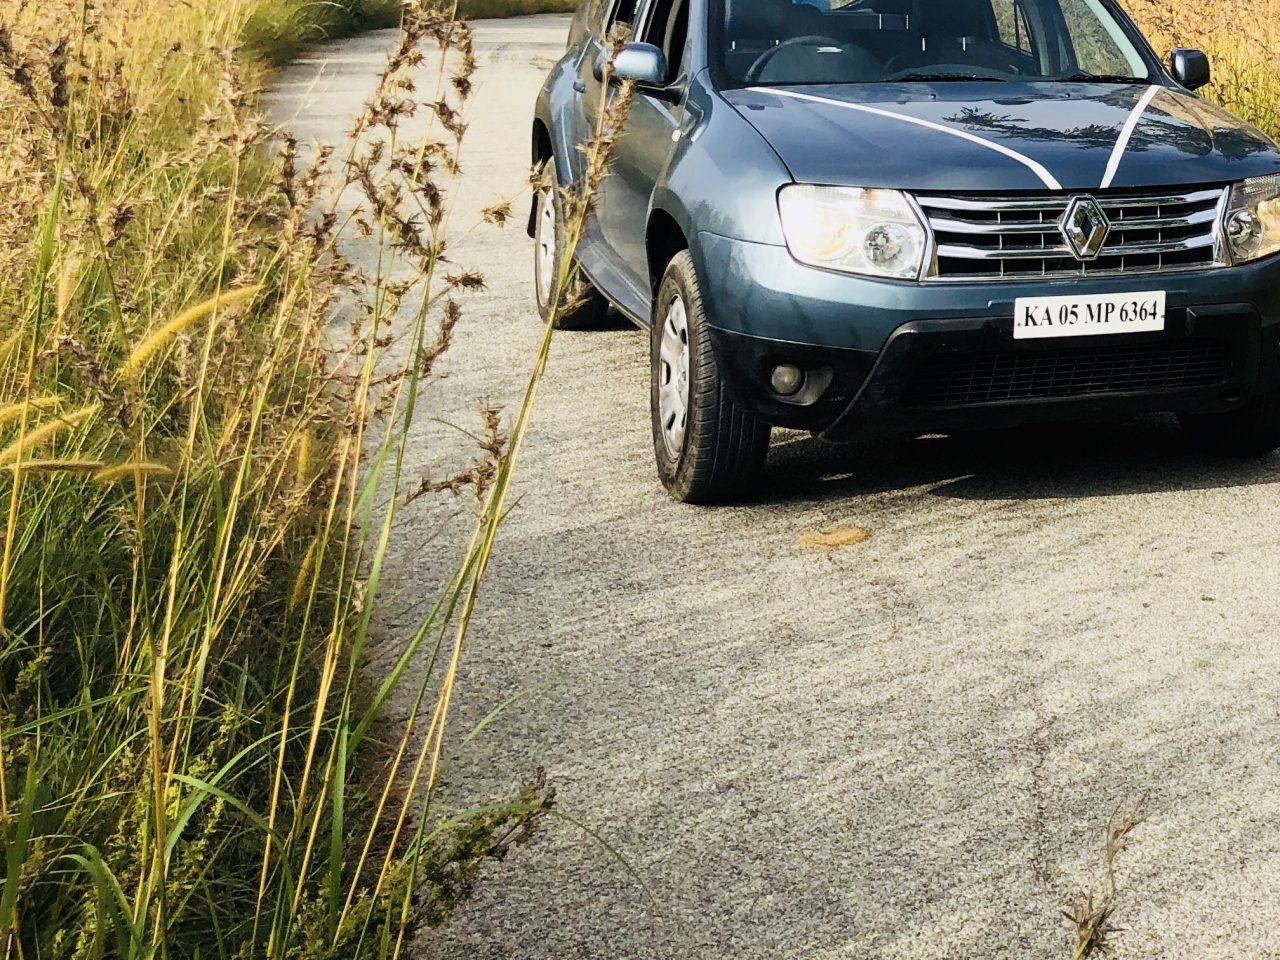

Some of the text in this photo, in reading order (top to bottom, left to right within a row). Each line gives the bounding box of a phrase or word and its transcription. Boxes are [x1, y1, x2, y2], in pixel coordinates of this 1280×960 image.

[1023, 300, 1158, 327] KA 05 MP 6364
